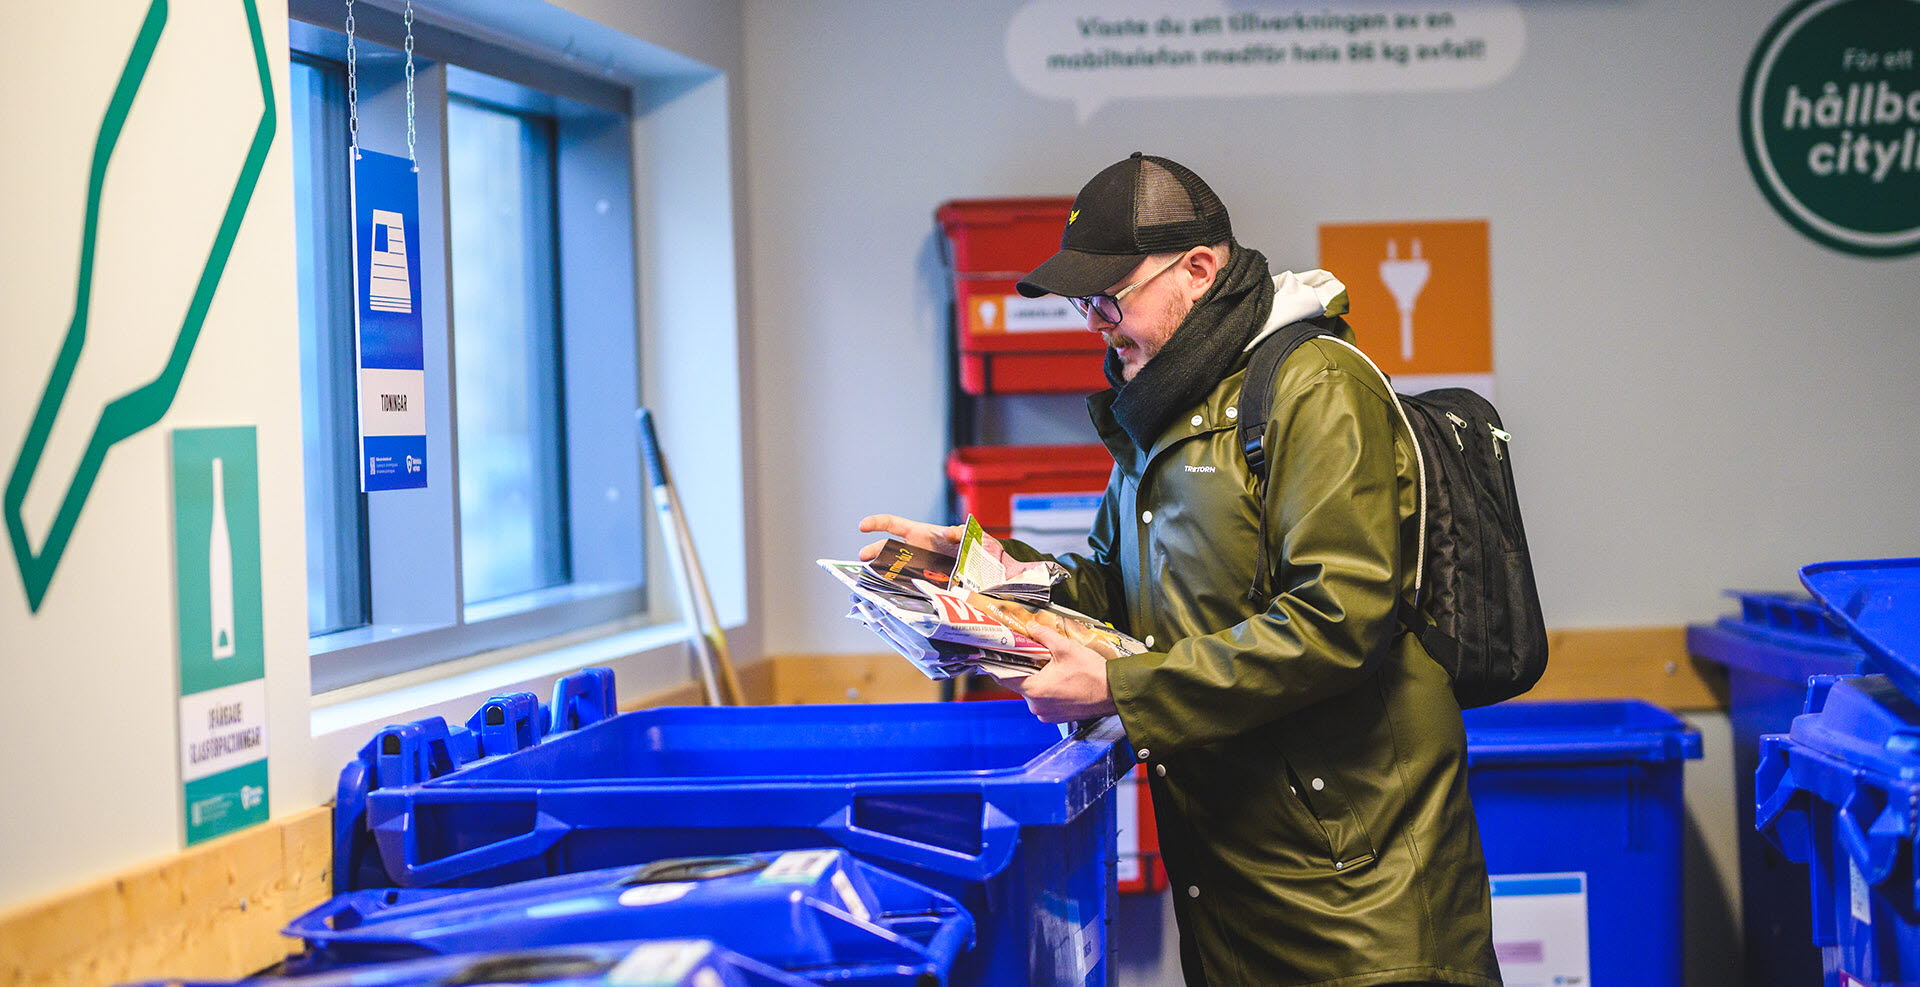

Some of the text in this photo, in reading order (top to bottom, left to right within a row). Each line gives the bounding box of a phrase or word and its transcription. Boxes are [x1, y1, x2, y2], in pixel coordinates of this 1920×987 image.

[1076, 11, 1455, 36] Visste du att tillverkningen av en
[1046, 47, 1195, 69] mobiltelefon
[1380, 41, 1410, 65] kg
[380, 394, 408, 412] TIDNINGAR
[1184, 465, 1216, 473] TRETORN
